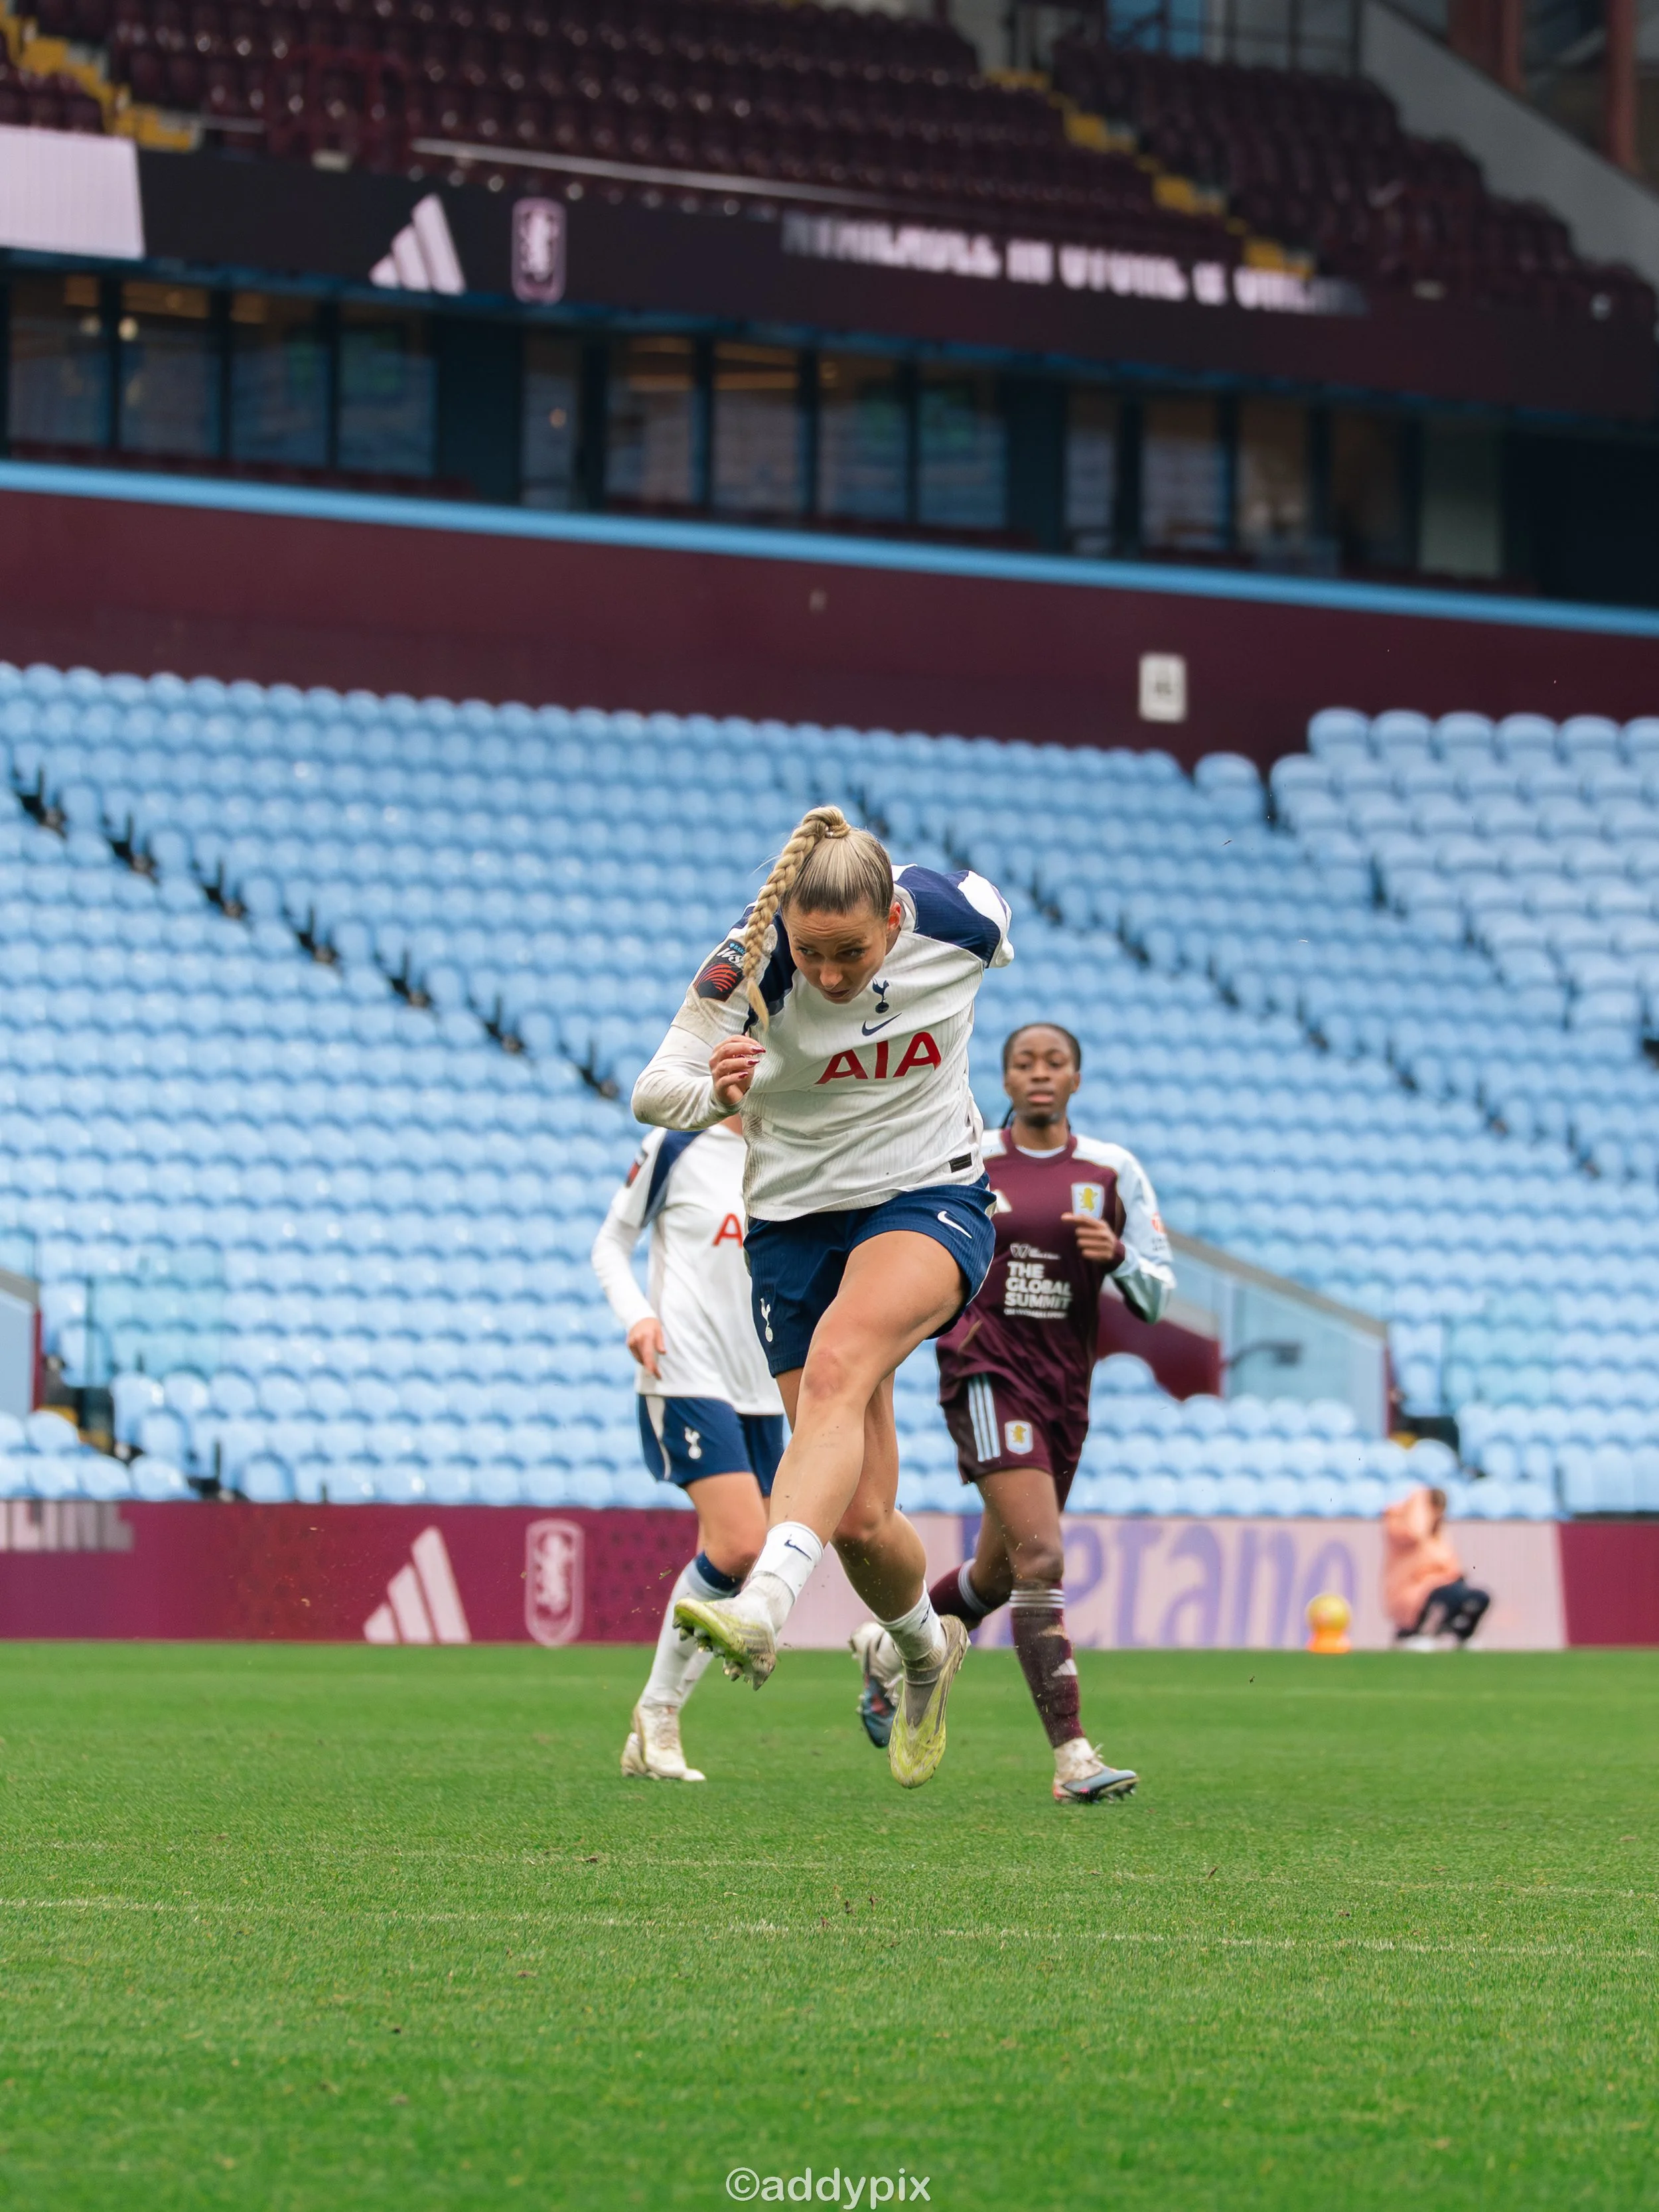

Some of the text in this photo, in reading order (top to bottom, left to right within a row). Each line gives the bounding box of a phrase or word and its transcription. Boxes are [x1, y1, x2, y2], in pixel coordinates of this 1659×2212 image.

[814, 1031, 942, 1084] AIA
[1007, 1261, 1045, 1280] THE
[1005, 1276, 1072, 1296] GLOBAL
[1004, 1291, 1072, 1310] SUMMIT
